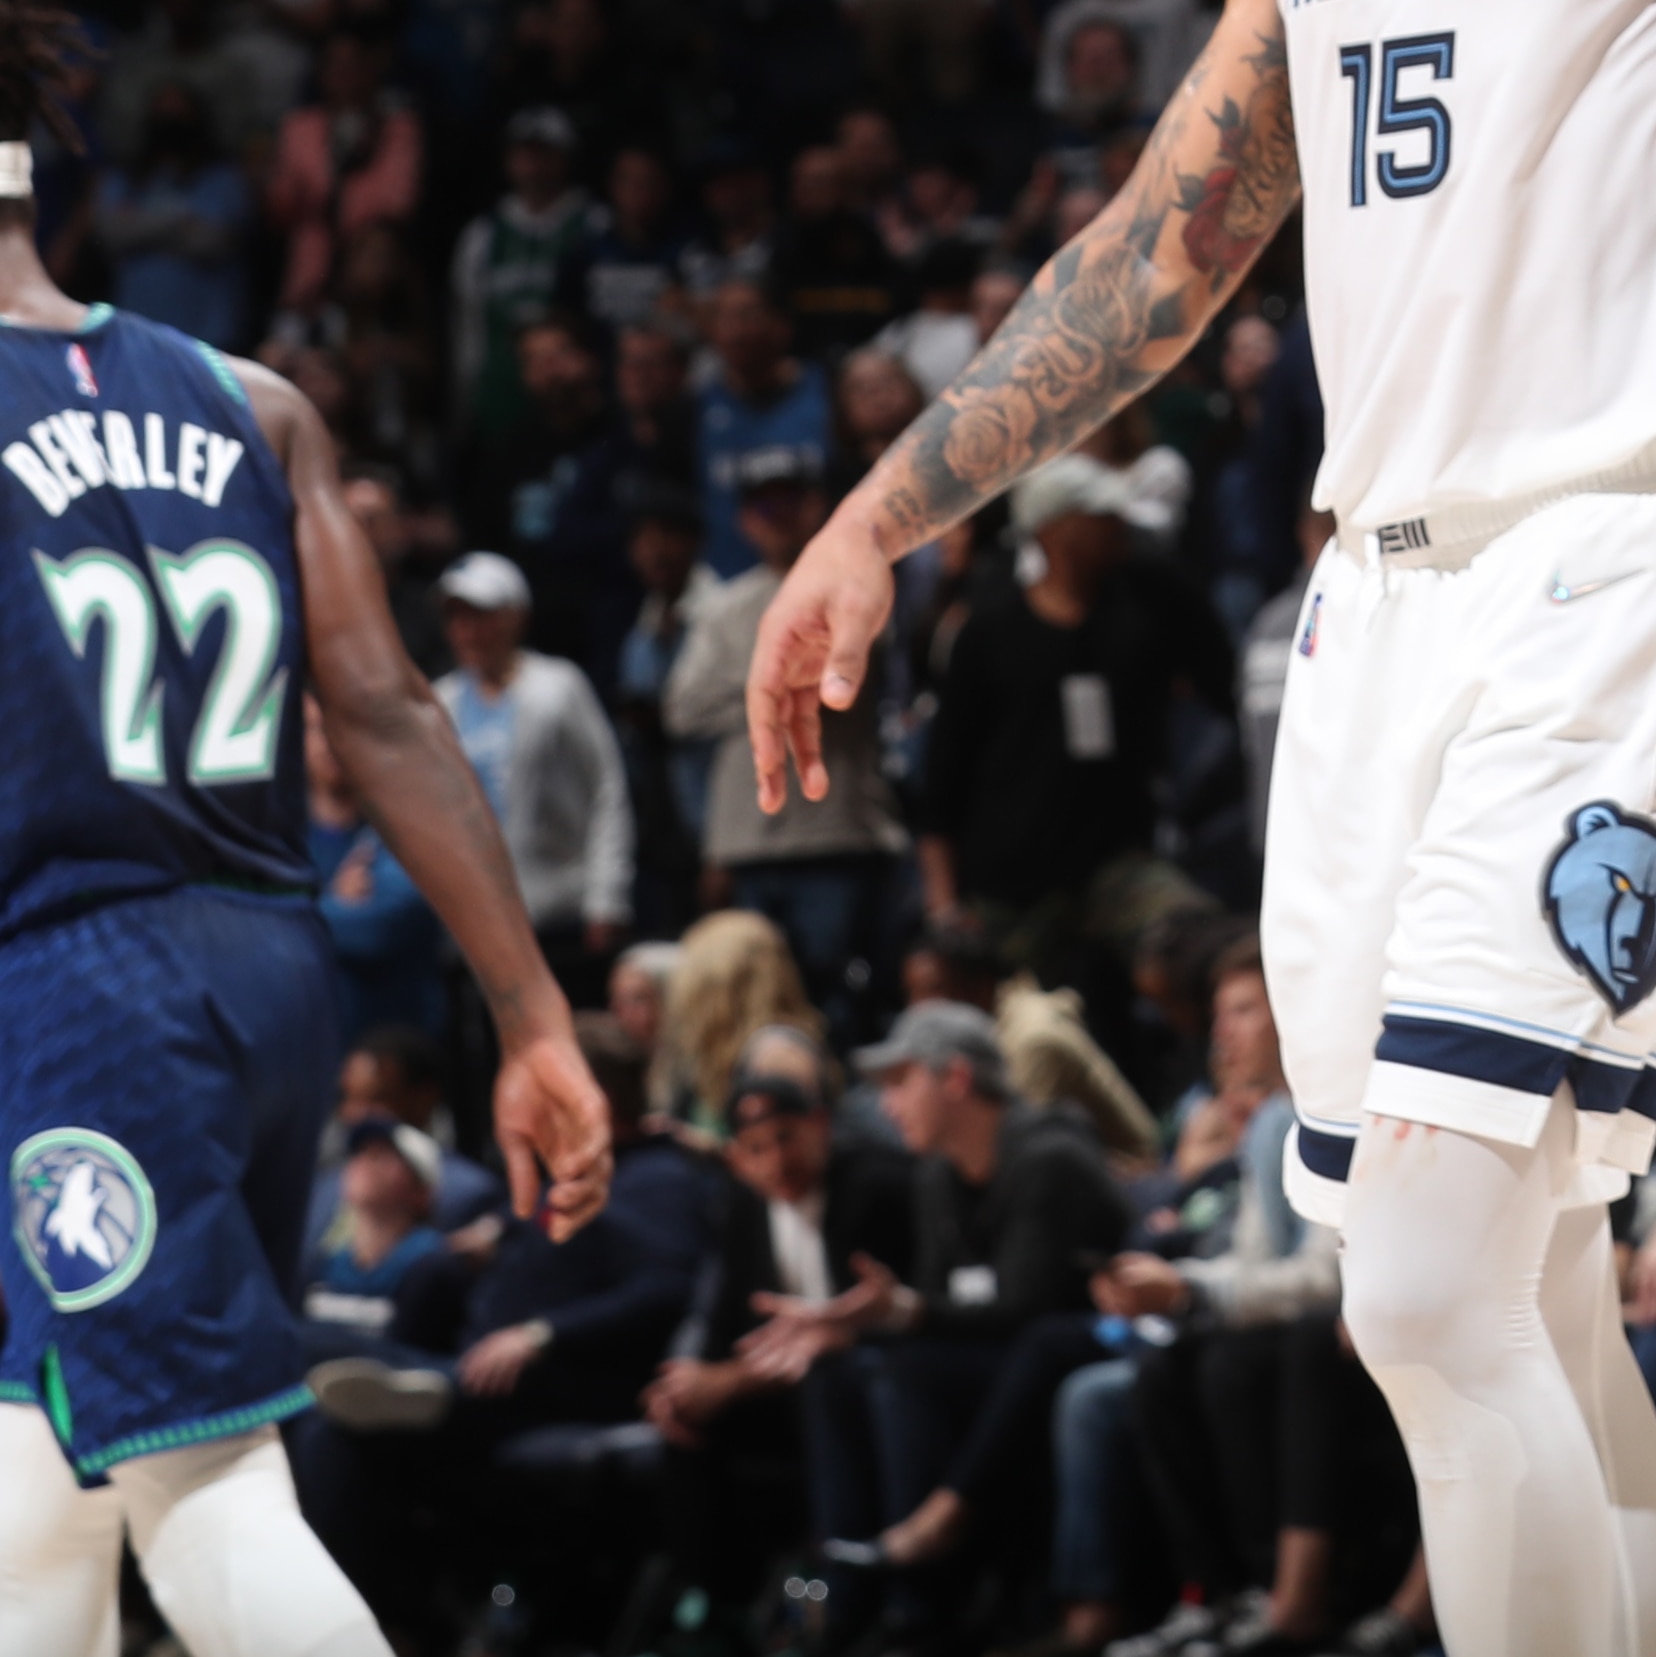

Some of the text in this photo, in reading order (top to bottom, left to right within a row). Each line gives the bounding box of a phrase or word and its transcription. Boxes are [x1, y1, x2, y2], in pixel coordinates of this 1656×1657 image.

[1339, 30, 1456, 208] 15
[1, 407, 245, 518] BEVERLEY
[31, 537, 290, 787] 22
